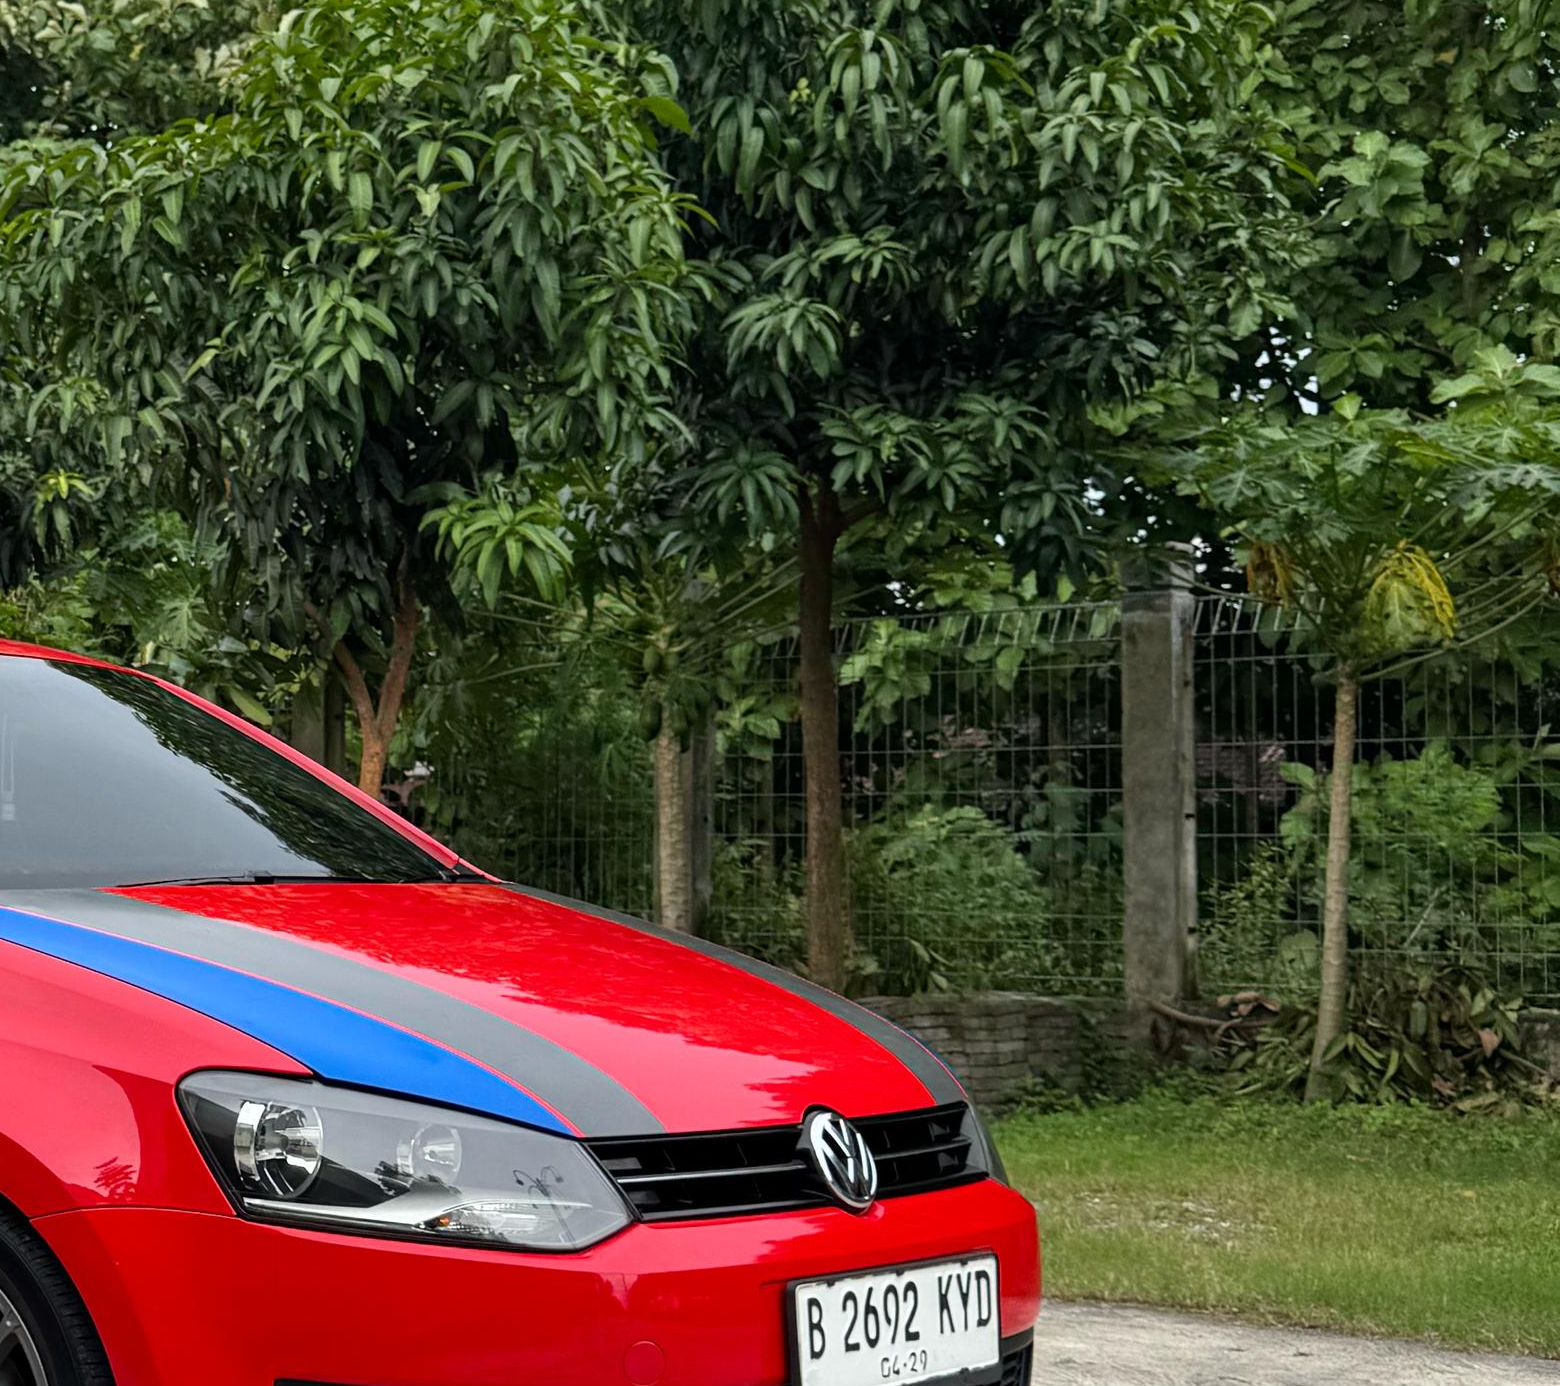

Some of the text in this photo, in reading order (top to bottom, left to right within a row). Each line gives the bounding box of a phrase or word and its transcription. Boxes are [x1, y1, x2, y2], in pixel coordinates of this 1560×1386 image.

[807, 1269, 991, 1360] B 2692 KYD
